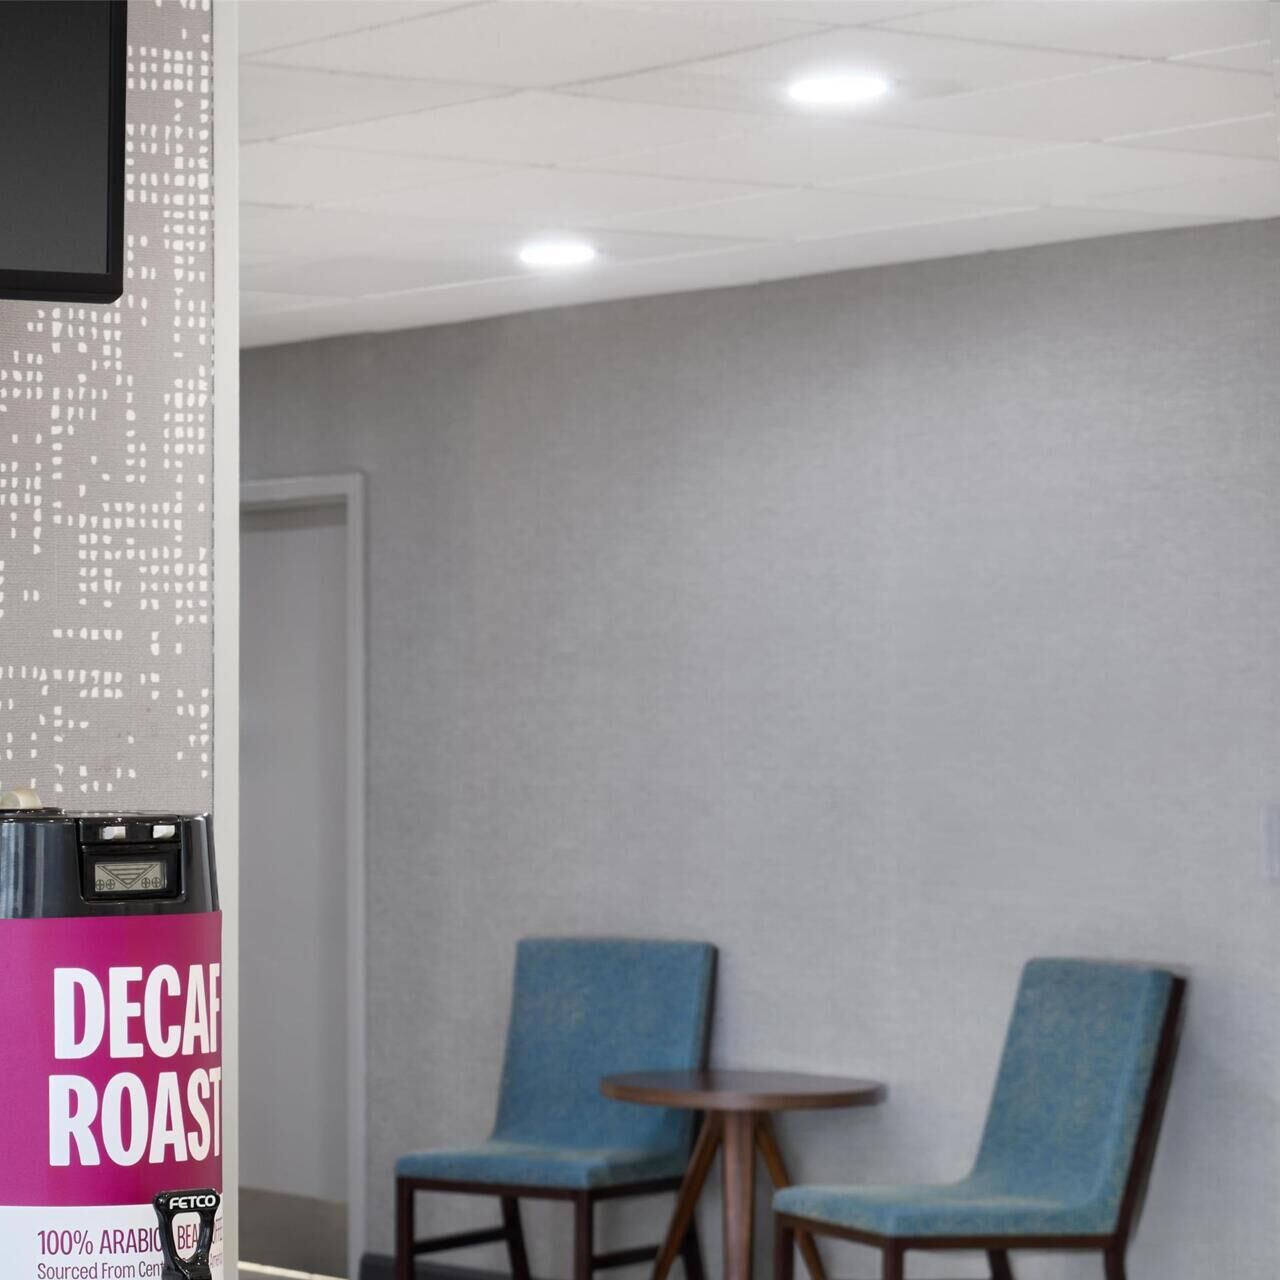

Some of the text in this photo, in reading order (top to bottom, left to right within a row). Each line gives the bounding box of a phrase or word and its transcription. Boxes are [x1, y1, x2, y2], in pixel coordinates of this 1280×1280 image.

[54, 963, 220, 1059] DECAF
[48, 1067, 222, 1167] ROAST
[169, 1194, 216, 1210] FETCO
[37, 1229, 94, 1255] 100%
[37, 1262, 98, 1280] Sourced
[101, 1263, 136, 1279] From
